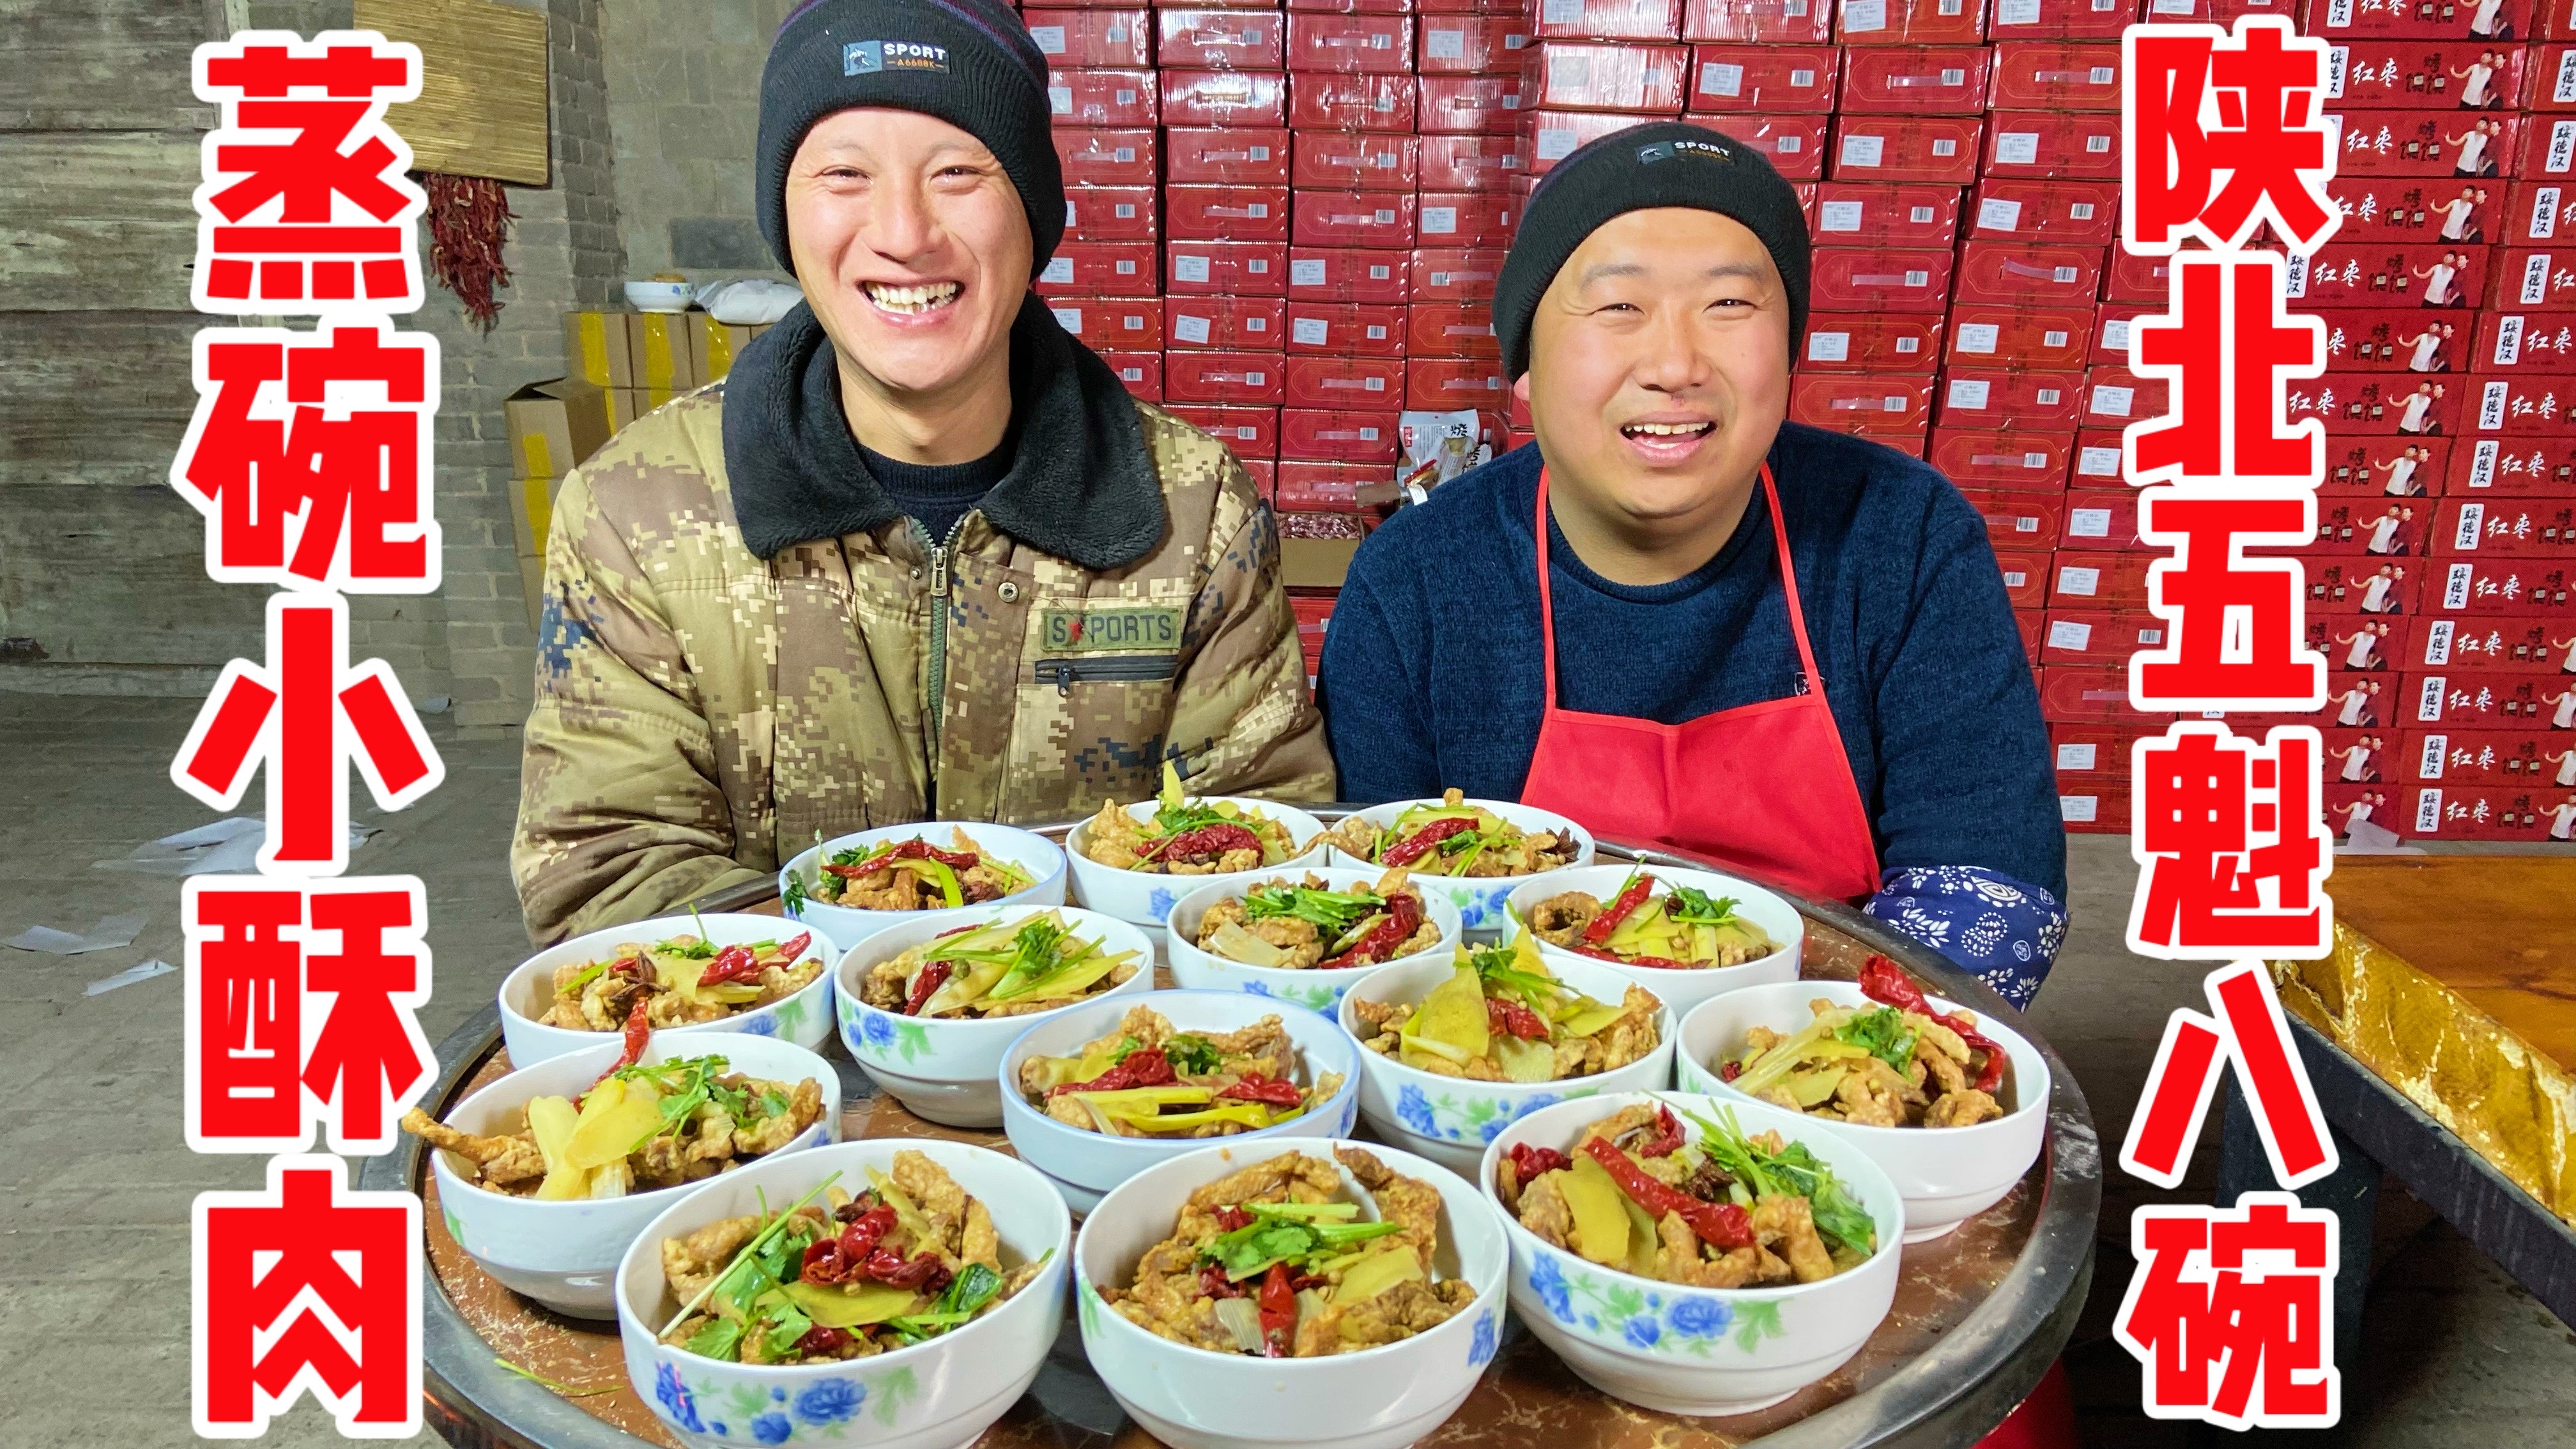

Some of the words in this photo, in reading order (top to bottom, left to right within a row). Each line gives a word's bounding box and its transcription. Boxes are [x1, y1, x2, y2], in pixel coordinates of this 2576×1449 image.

[884, 43, 946, 61] SPORT
[2352, 57, 2398, 88] 红枣
[1674, 141, 1730, 157] SPORT
[2346, 126, 2393, 155] 红枣
[2334, 193, 2378, 222] 红枣
[2314, 259, 2361, 288] 红枣
[2527, 326, 2573, 355] 红枣
[2289, 388, 2337, 415] 红枣
[2511, 392, 2557, 420] 红枣
[2501, 450, 2546, 478] 红枣
[2487, 513, 2533, 540] 红枣
[2476, 574, 2522, 601] 红枣
[2457, 630, 2503, 657] 红枣
[2450, 686, 2494, 713] 红枣
[2451, 745, 2496, 771] 红枣
[2446, 799, 2490, 824] 红枣
